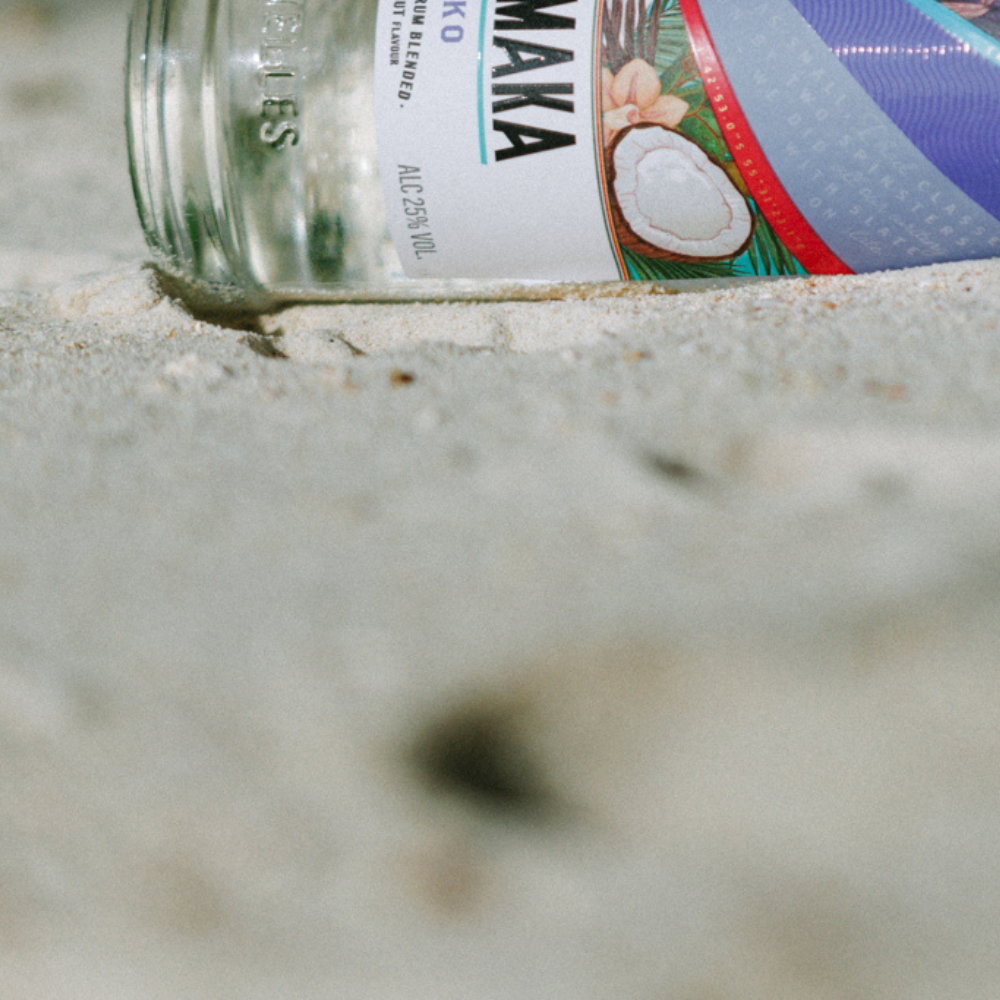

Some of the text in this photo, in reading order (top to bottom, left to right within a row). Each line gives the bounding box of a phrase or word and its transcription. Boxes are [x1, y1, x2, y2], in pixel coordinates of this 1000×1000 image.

[389, 21, 403, 66] FLAVOUR
[397, 31, 424, 101] BLENDED
[398, 164, 436, 260] ALC 25% VOL.
